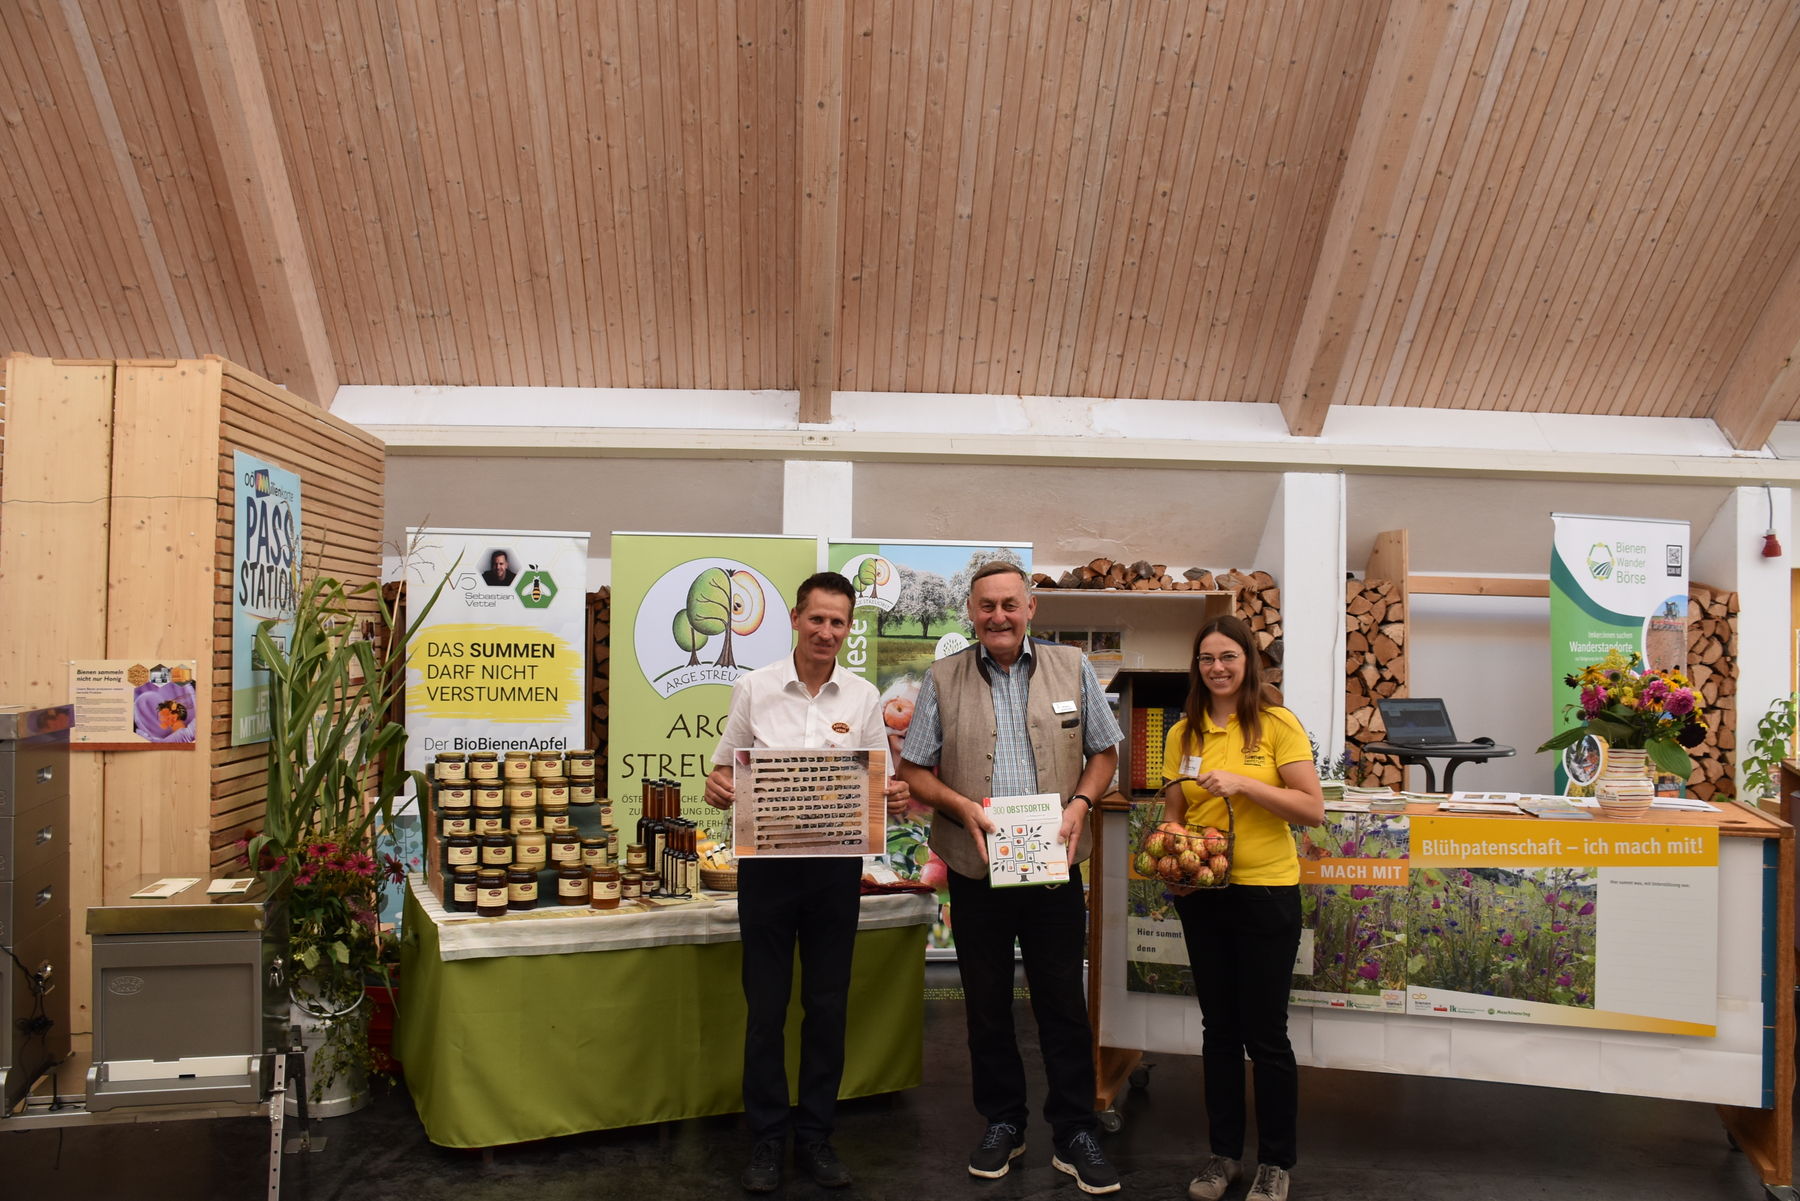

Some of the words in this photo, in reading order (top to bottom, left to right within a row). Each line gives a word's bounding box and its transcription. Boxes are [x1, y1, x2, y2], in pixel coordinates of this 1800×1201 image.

[246, 495, 293, 569] PASS
[1616, 541, 1647, 556] Bienen
[1616, 557, 1647, 568] Wander
[239, 559, 297, 611] STATION
[1616, 570, 1647, 585] Börse
[465, 592, 515, 601] Sebastian
[465, 600, 497, 608] Vettel
[427, 642, 464, 658] DAS
[470, 642, 555, 659] SUMMEN
[1569, 640, 1633, 653] Wanderstandorte
[427, 664, 476, 680] DARF
[481, 664, 538, 681] NICHT
[666, 671, 699, 693] ARGE
[426, 686, 559, 702] VERSTUMMEN
[424, 737, 449, 751] Der
[453, 736, 567, 754] BioBienenApfel
[704, 807, 721, 816] DES
[992, 806, 1006, 815] 300
[1006, 803, 1051, 814] OBSTSORTEN
[1421, 838, 1562, 860] Blühpatenschaft
[1582, 837, 1609, 856] ich
[1614, 836, 1662, 857] mach
[1666, 835, 1703, 855] mit!
[1320, 864, 1367, 880] MACH
[1372, 865, 1403, 880] MIT
[1137, 927, 1154, 937] Hier
[1155, 930, 1182, 939] summt
[1136, 944, 1157, 953] denn
